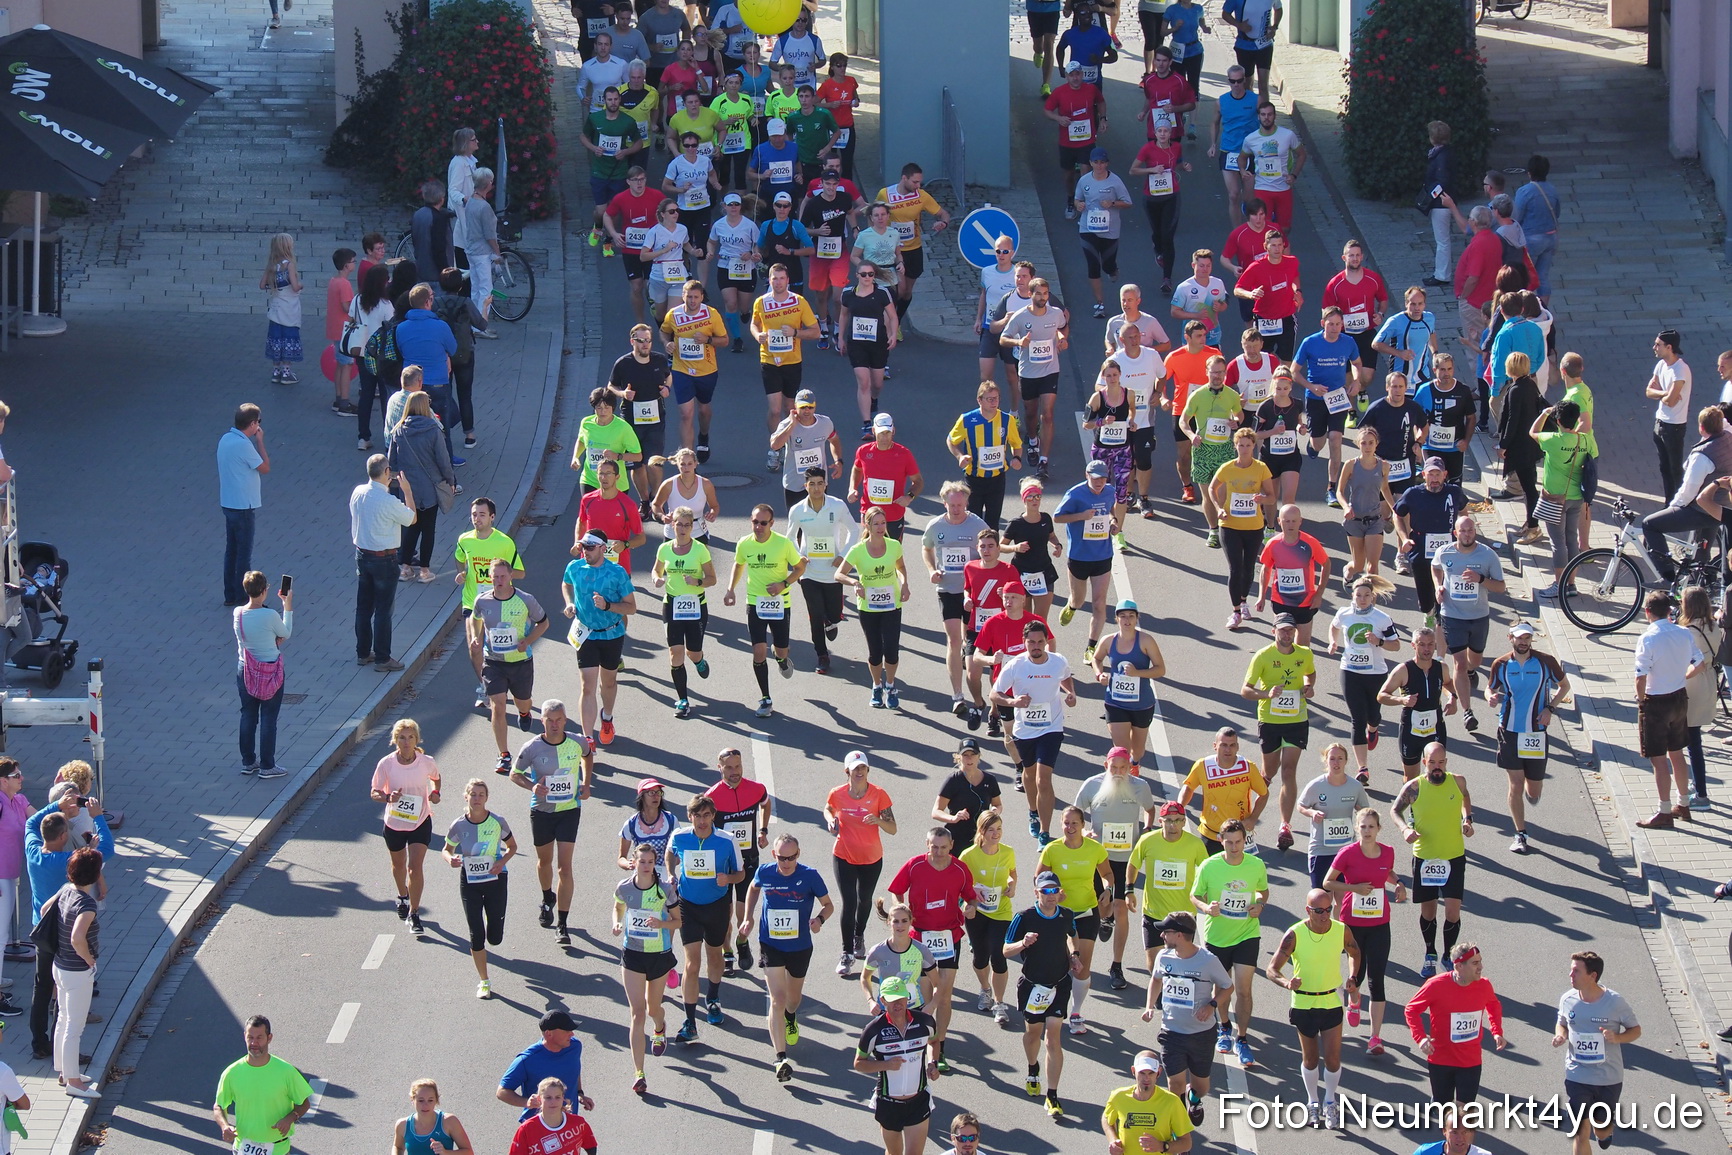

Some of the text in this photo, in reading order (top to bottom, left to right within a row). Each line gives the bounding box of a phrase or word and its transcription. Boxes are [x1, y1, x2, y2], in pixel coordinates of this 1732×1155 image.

[1083, 70, 1096, 78] 122
[1073, 125, 1086, 133] 267
[602, 140, 618, 149] 2105
[726, 138, 743, 146] 2214
[773, 167, 790, 175] 3026
[1154, 178, 1168, 187] 266
[690, 193, 703, 201] 252
[1090, 216, 1107, 224] 2014
[629, 232, 646, 241] 2430
[823, 242, 837, 250] 210
[667, 267, 681, 275] 250
[734, 263, 746, 271] 251
[764, 306, 801, 320] MAX BÖGL
[677, 320, 713, 334] MAX BÖGL
[856, 323, 874, 332] 3047
[1261, 318, 1278, 327] 2437
[1347, 318, 1366, 328] 2438
[771, 335, 789, 344] 2411
[682, 344, 701, 352] 2408
[1032, 345, 1051, 355] 2630
[1254, 389, 1267, 397] 191
[641, 407, 652, 415] 64
[1104, 427, 1123, 436] 2037
[1212, 424, 1227, 434] 343
[1432, 430, 1452, 440] 2500
[1274, 437, 1293, 446] 2038
[799, 454, 819, 466] 2305
[983, 451, 1002, 462] 3059
[1389, 462, 1407, 472] 2391
[872, 485, 888, 495] 355
[1234, 499, 1254, 508] 2516
[1091, 522, 1104, 531] 165
[813, 542, 828, 551] 351
[946, 554, 967, 563] 2218
[1023, 578, 1042, 588] 2154
[1281, 575, 1301, 584] 2270
[1454, 582, 1475, 591] 2186
[870, 593, 891, 602] 2295
[677, 601, 696, 610] 2291
[760, 600, 781, 610] 2292
[493, 634, 513, 644] 2221
[1349, 653, 1370, 663] 2259
[1115, 681, 1136, 692] 2623
[1278, 697, 1294, 706] 223
[1025, 709, 1047, 720] 2272
[1419, 718, 1429, 727] 41
[1524, 738, 1541, 748] 332
[550, 782, 572, 792] 2894
[1207, 780, 1227, 790] MAX
[398, 800, 415, 812] 254
[1110, 830, 1127, 841] 144
[1328, 826, 1350, 836] 3002
[469, 862, 490, 873] 2897
[693, 858, 706, 868] 33
[1161, 868, 1178, 879] 291
[1425, 865, 1447, 875] 2633
[1224, 898, 1247, 909] 2173
[1360, 897, 1377, 907] 146
[774, 917, 792, 927] 317
[926, 938, 948, 949] 2451
[1166, 984, 1190, 996] 2159
[1456, 1019, 1478, 1031] 2310
[1576, 1040, 1599, 1051] 2547
